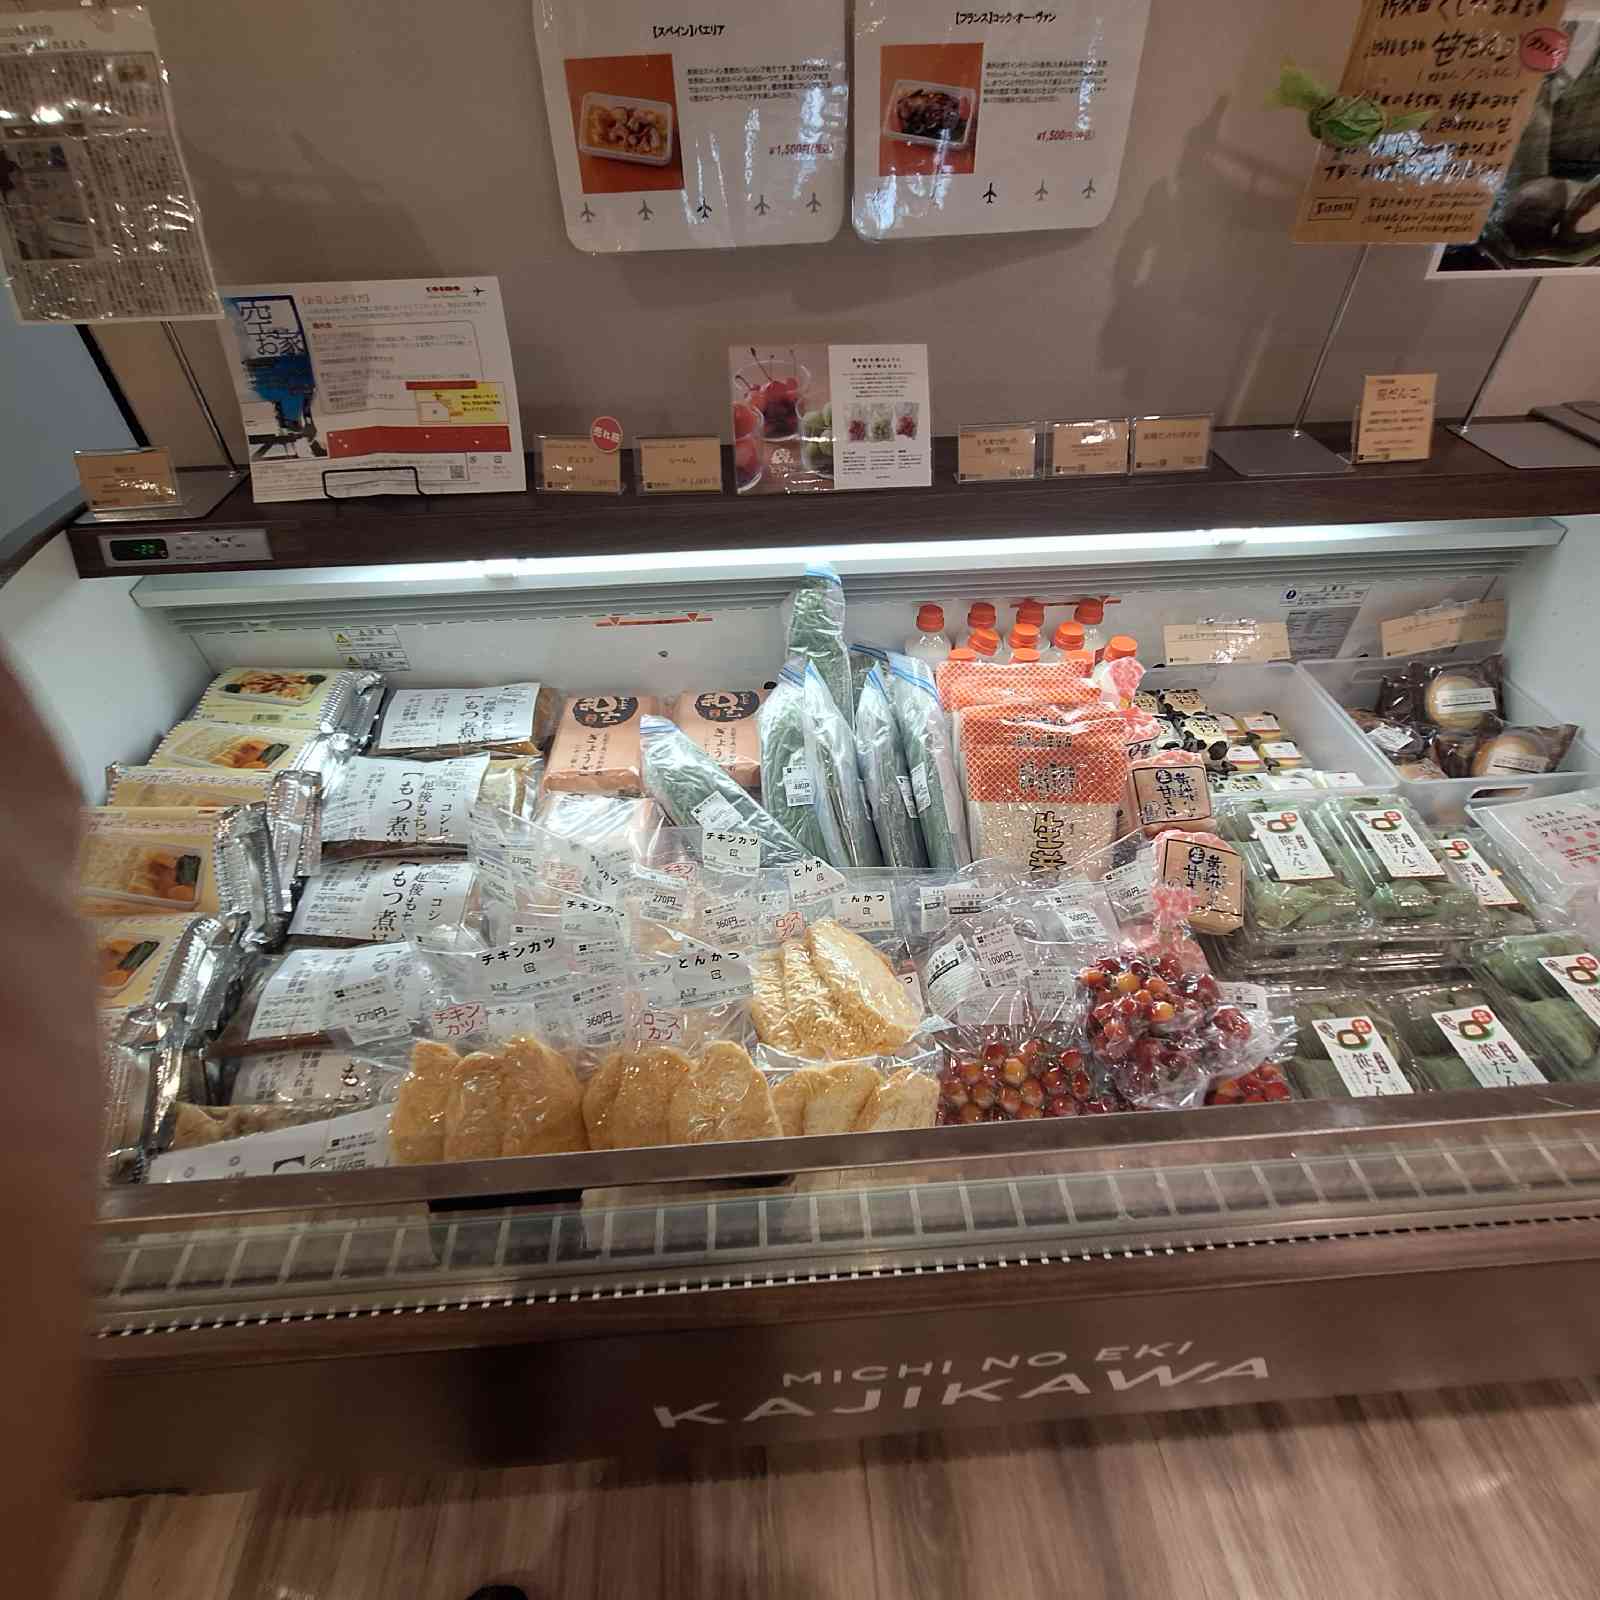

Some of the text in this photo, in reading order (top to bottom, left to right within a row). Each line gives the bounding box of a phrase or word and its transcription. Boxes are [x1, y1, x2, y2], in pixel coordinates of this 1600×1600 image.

[955, 11, 1057, 25] 【フランス】コック・オー・ヴァン
[652, 24, 726, 39] 【スペイン】パエリア
[705, 832, 759, 847] チキンカツ
[481, 936, 557, 967] チキンカツ
[678, 951, 741, 970] とんかつ
[354, 1006, 389, 1024] 270円
[433, 1004, 482, 1025] チキン
[585, 1009, 614, 1028] 360円
[642, 1012, 681, 1030] ロース
[446, 1019, 477, 1037] カツ
[647, 1027, 674, 1041] カツ
[1478, 1042, 1517, 1086] 笹だん
[1352, 1052, 1385, 1097] 笹だん
[782, 1341, 1194, 1387] MICHI NO EKI
[653, 1356, 1269, 1429] KAJIKAWA
